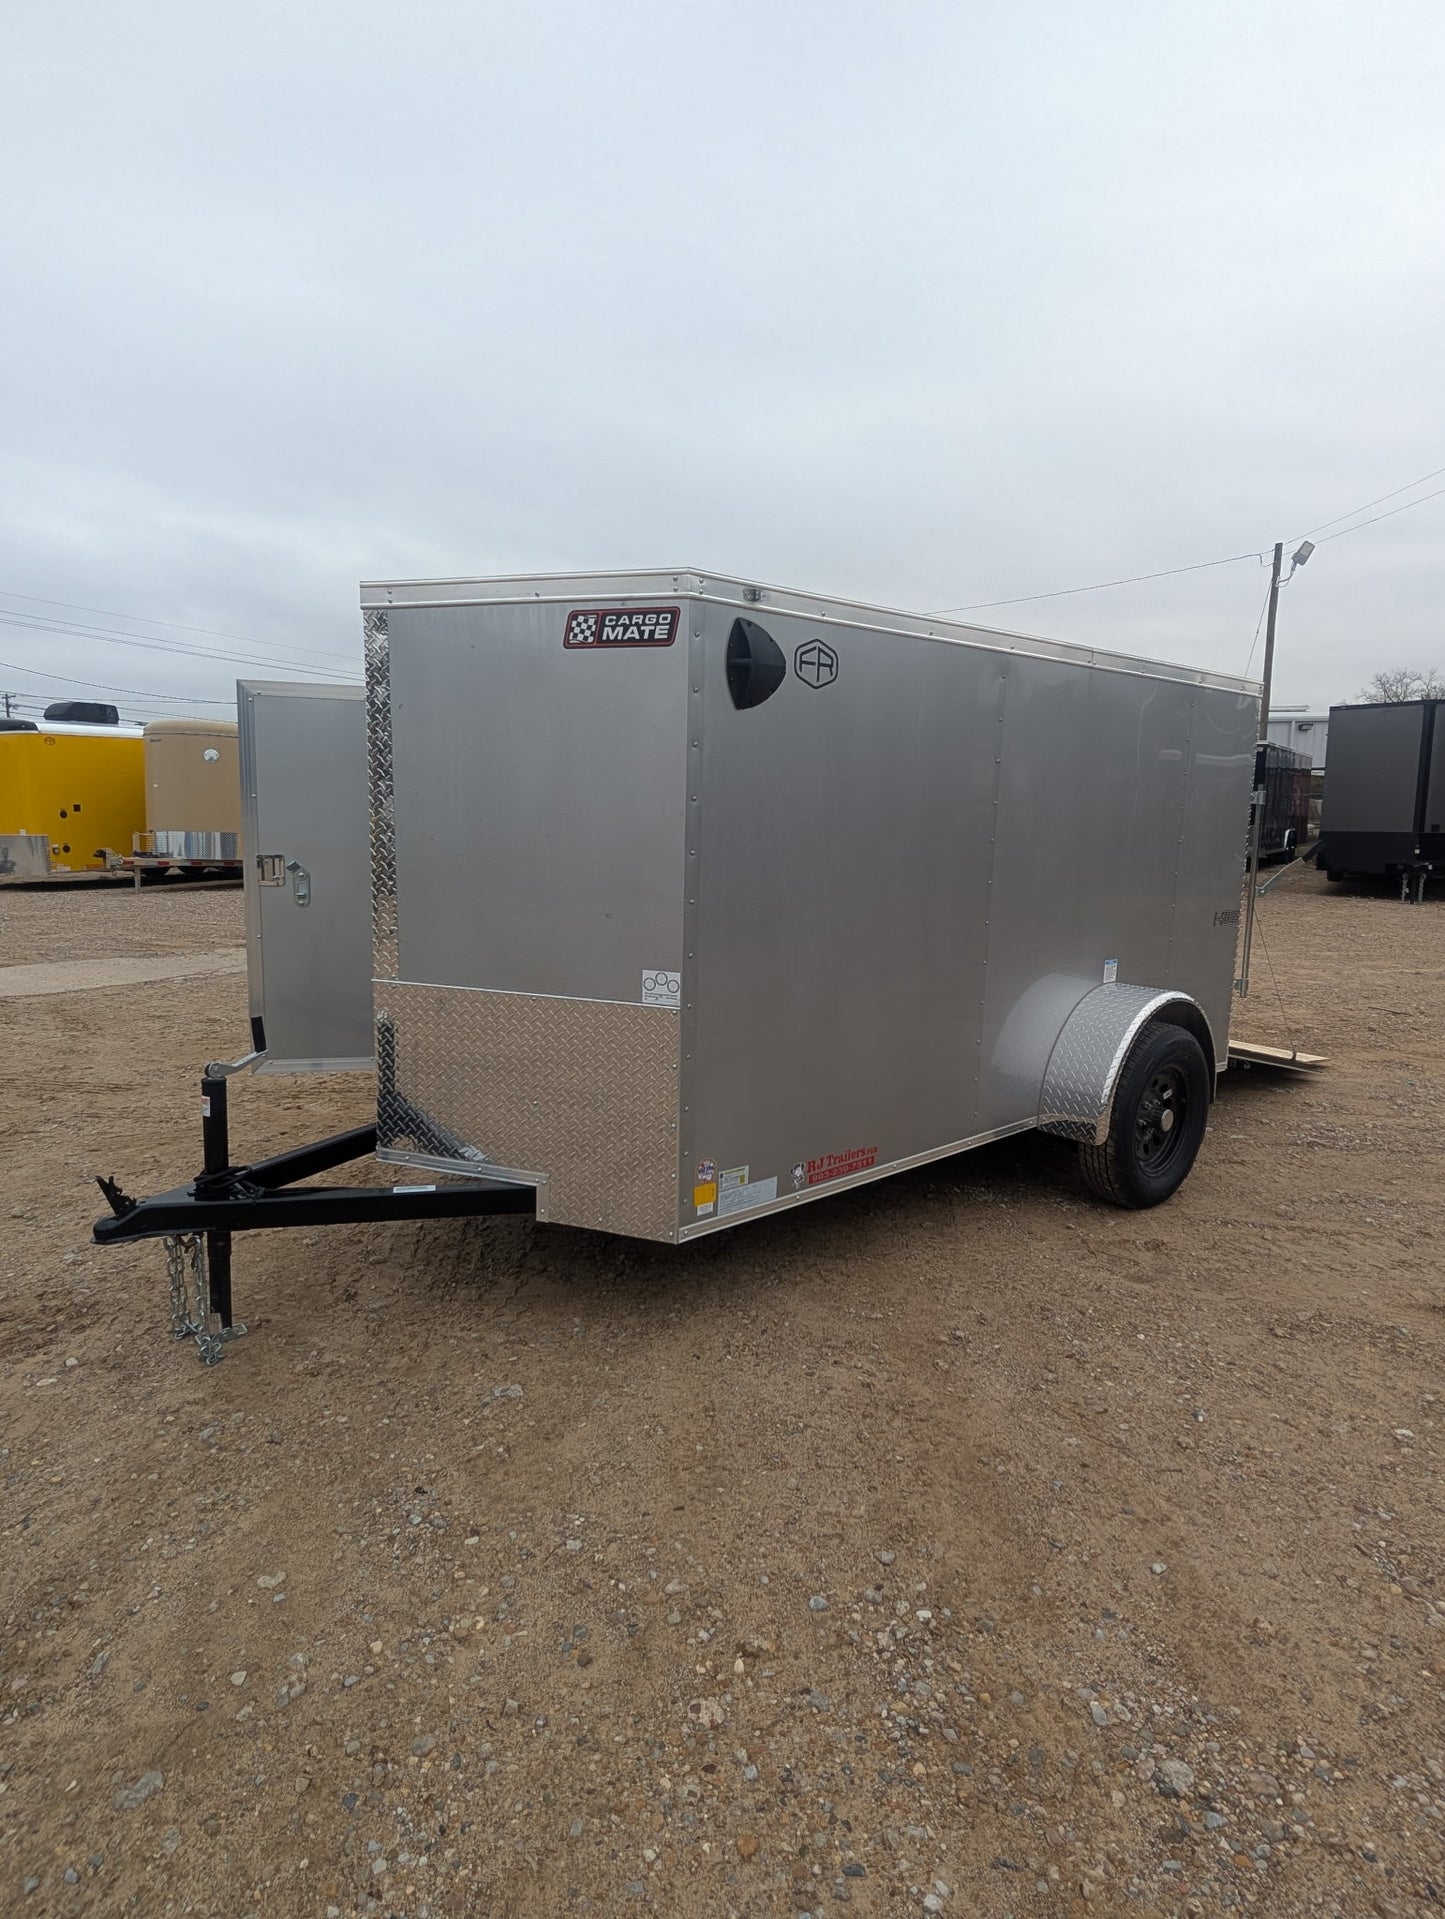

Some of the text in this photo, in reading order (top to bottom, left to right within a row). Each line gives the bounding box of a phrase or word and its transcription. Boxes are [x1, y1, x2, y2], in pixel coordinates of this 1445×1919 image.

[605, 613, 671, 625] CARGO
[602, 625, 670, 640] MATE
[806, 1156, 825, 1173] RJ
[826, 1147, 866, 1167] Trailers
